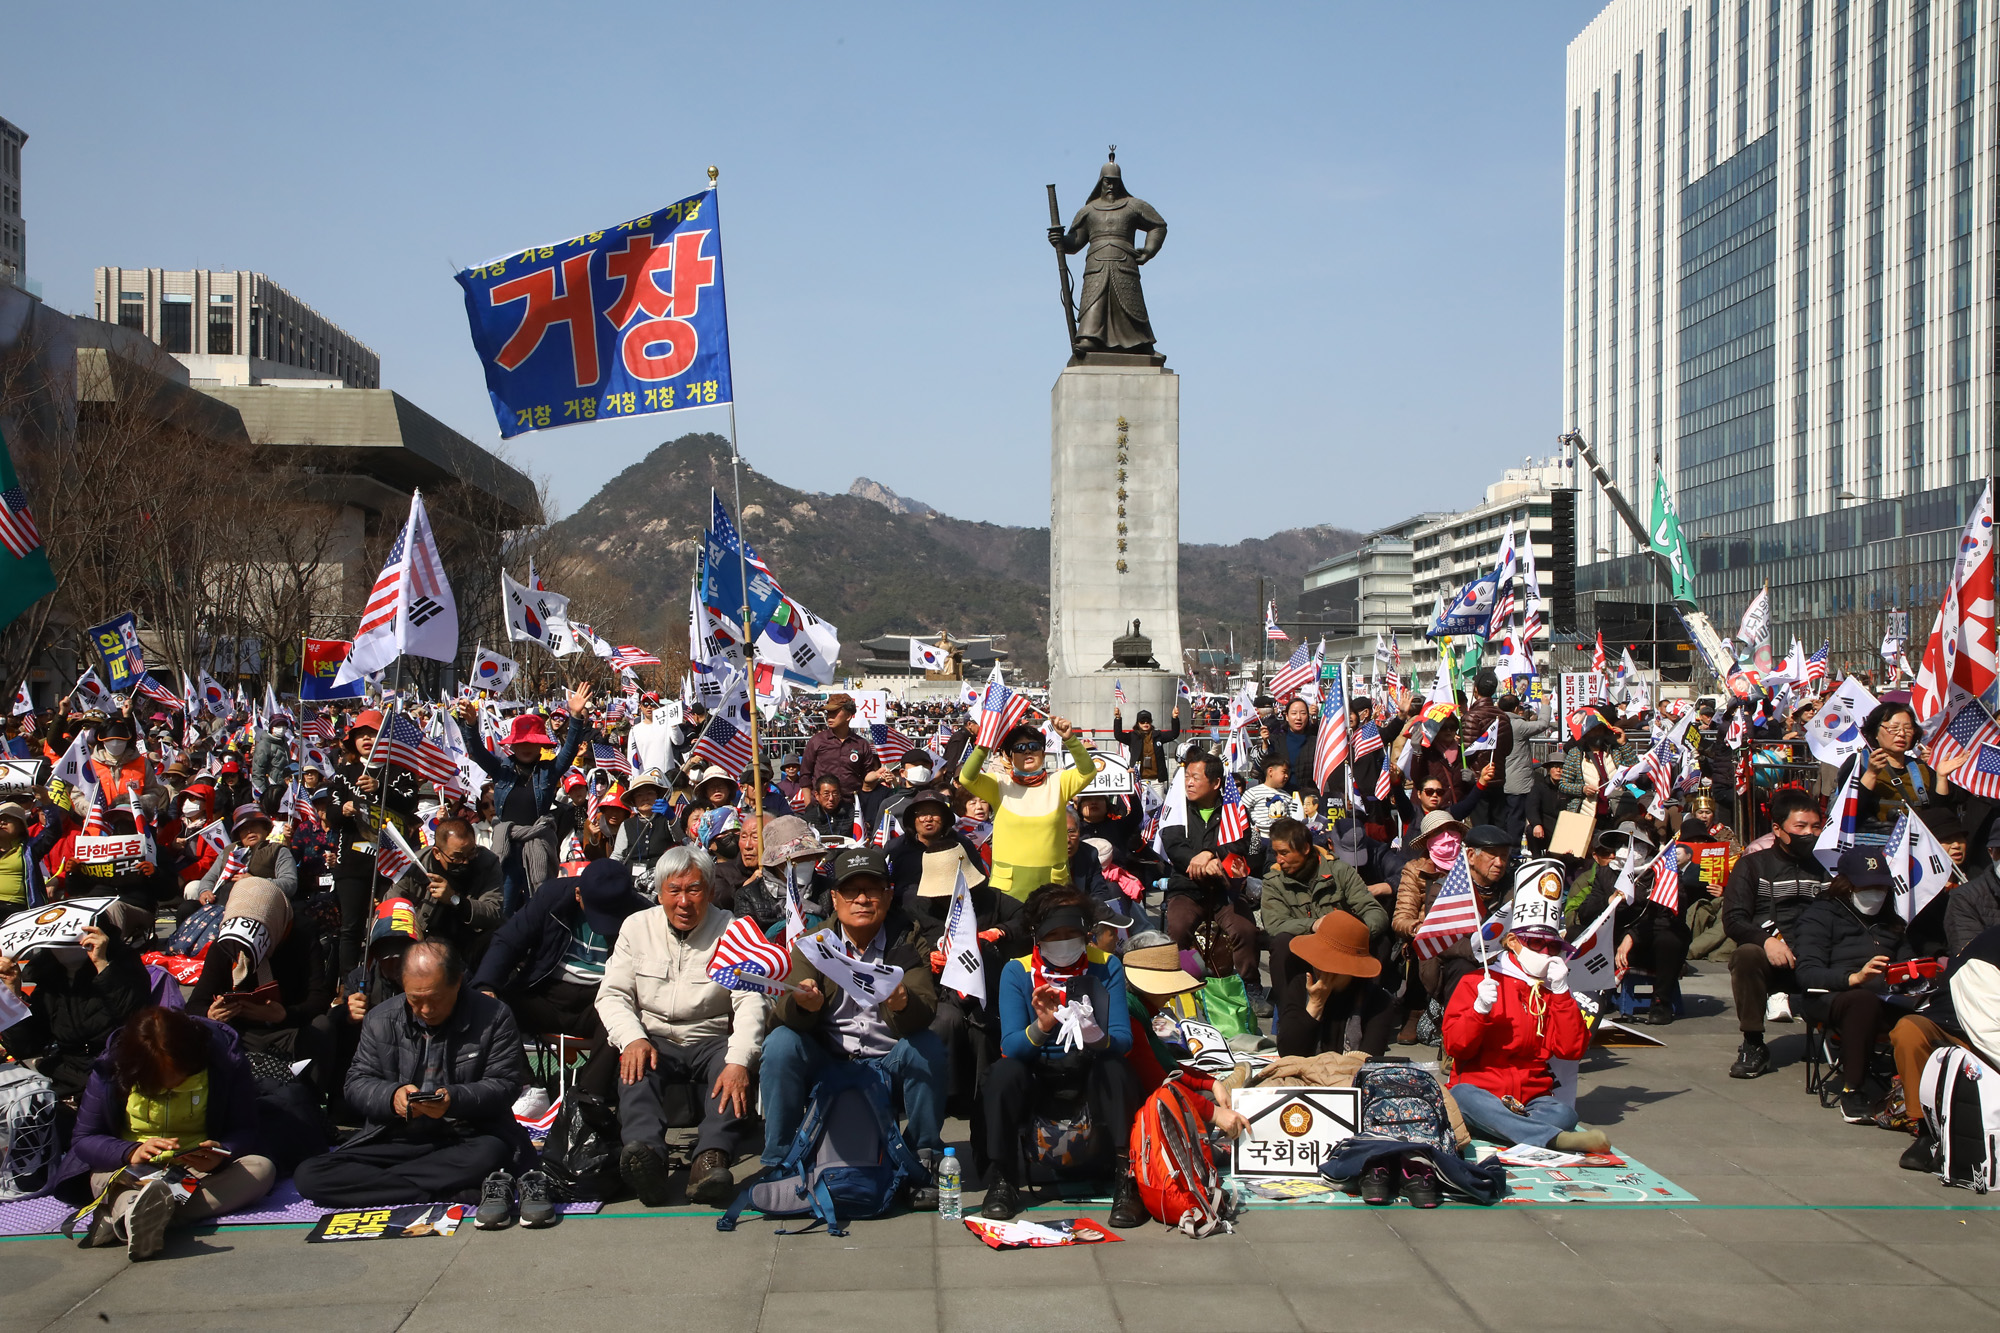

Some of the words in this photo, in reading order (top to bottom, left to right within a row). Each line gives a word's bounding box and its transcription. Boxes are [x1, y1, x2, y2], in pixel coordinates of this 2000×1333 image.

[470, 259, 507, 280] 거창
[519, 246, 555, 264] 거창
[666, 199, 703, 223] 거창
[490, 228, 716, 389] 거창
[516, 404, 552, 428] 거창
[564, 397, 597, 419] 거창
[606, 390, 636, 414] 거창
[644, 385, 676, 409] 거창
[686, 380, 719, 402] 거창
[76, 840, 141, 862] 탄핵무효
[3, 918, 82, 951] 국회해산
